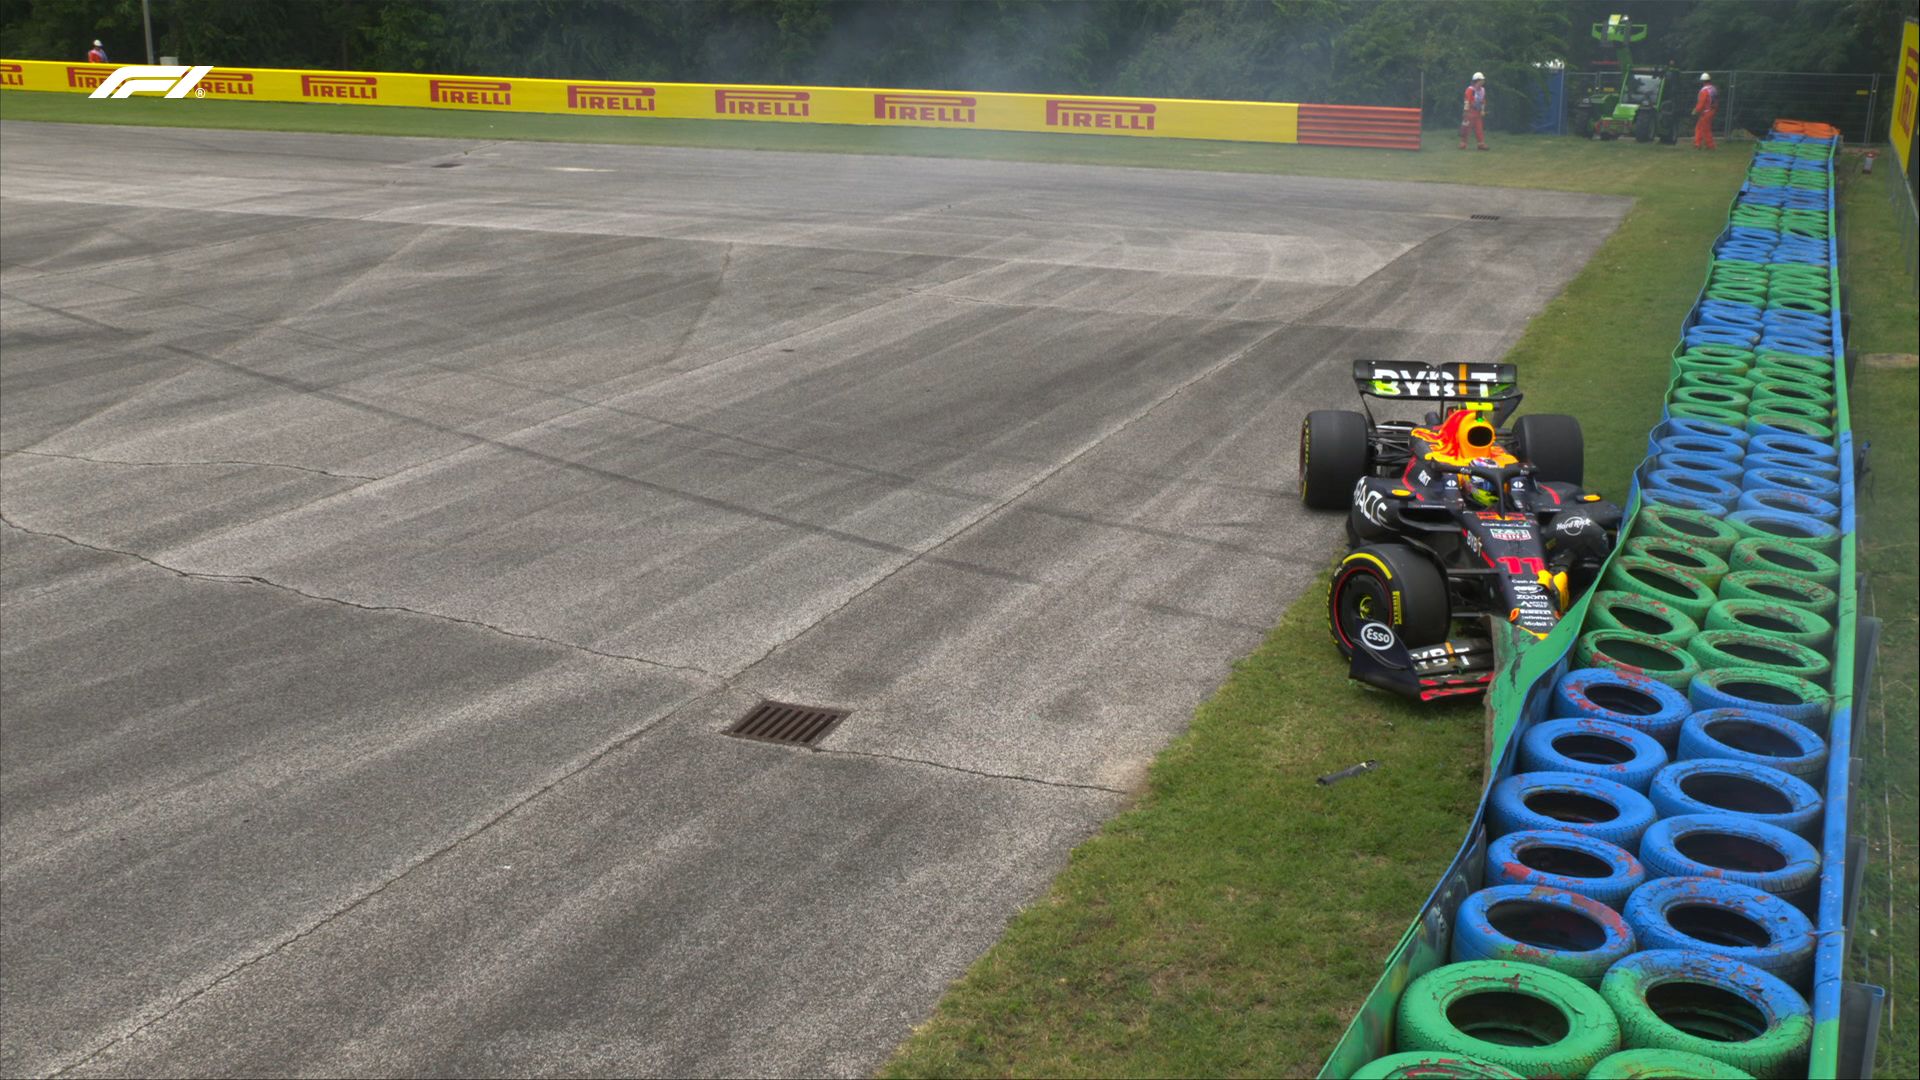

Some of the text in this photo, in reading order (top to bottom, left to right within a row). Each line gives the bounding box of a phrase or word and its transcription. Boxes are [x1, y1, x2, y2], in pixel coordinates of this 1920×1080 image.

[301, 75, 377, 99] PIRELLI
[430, 80, 511, 106] PIRELLI
[567, 85, 656, 112] PIRELLI
[715, 90, 810, 117] PIRELLI
[873, 94, 977, 123] PIRELLI
[1046, 100, 1156, 130] PIRELLI
[1373, 364, 1497, 398] BYBIT
[1556, 520, 1574, 531] Hard
[1497, 556, 1545, 574] 11
[1366, 628, 1390, 643] Esso
[1411, 641, 1470, 670] YBIT
